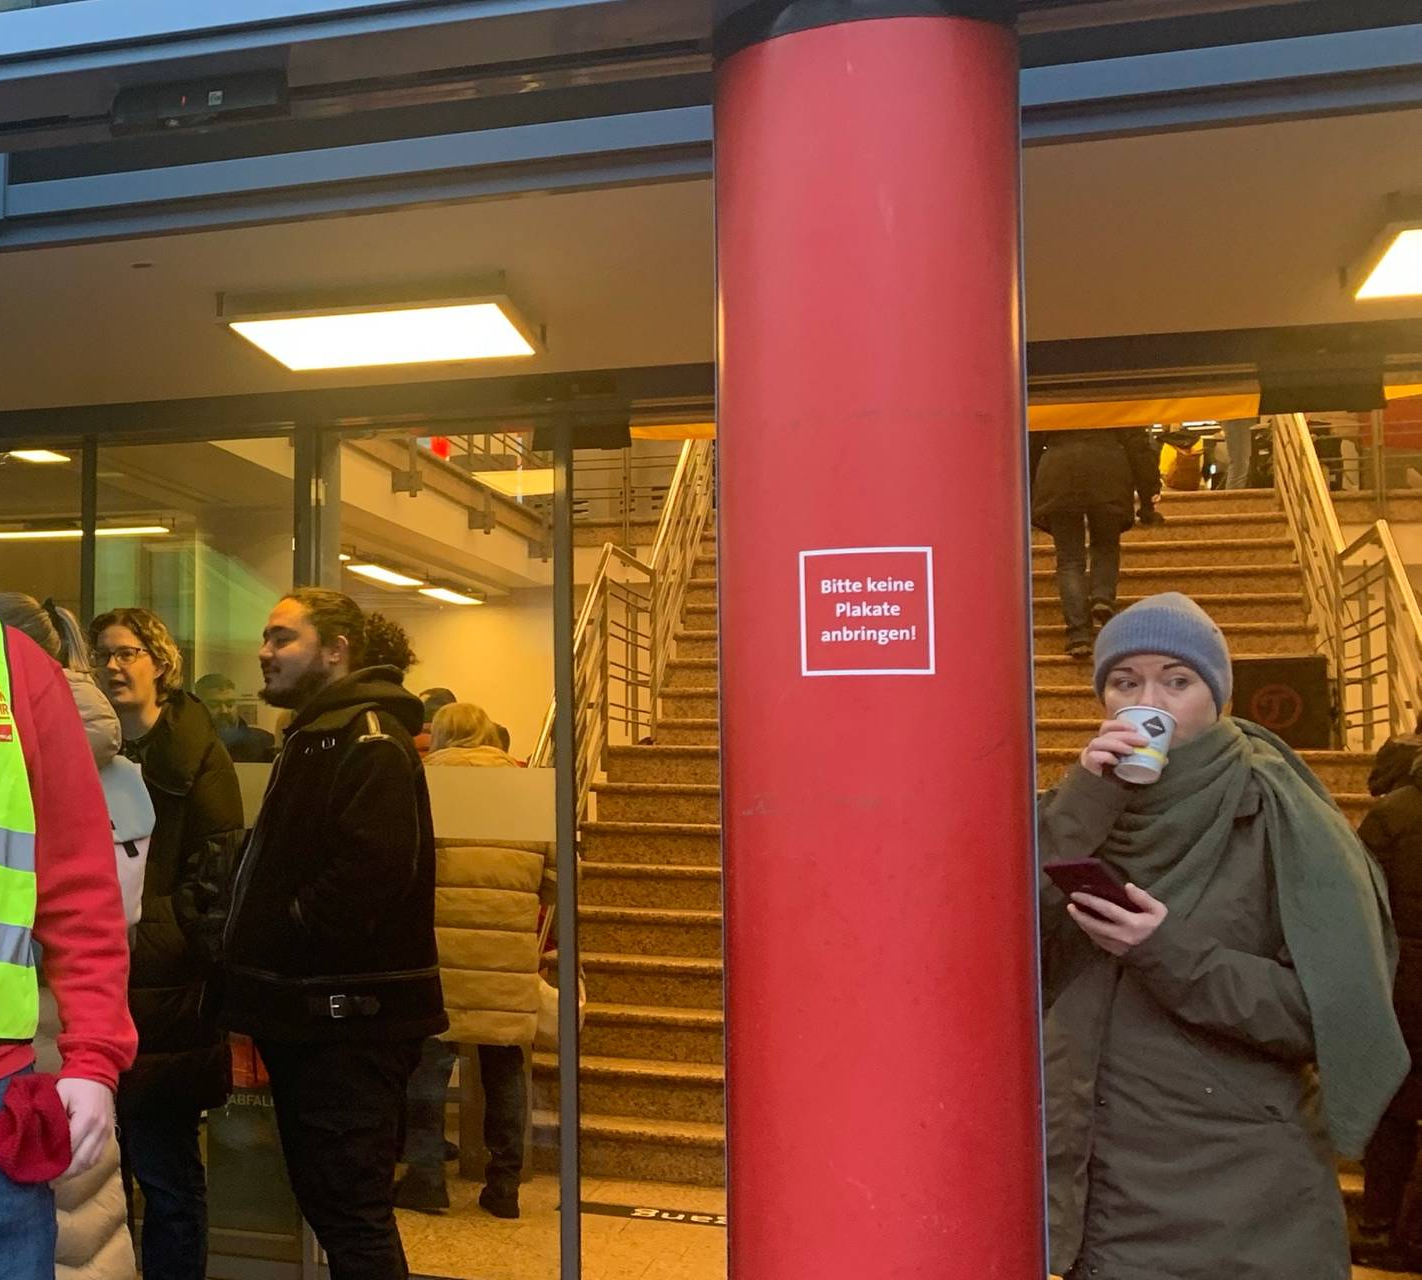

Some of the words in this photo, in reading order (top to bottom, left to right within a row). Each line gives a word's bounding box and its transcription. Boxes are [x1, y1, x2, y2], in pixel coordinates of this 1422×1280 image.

[821, 578, 862, 594] Bitte
[866, 576, 915, 593] keine
[835, 601, 901, 617] Plakate
[821, 625, 916, 645] anbringen!
